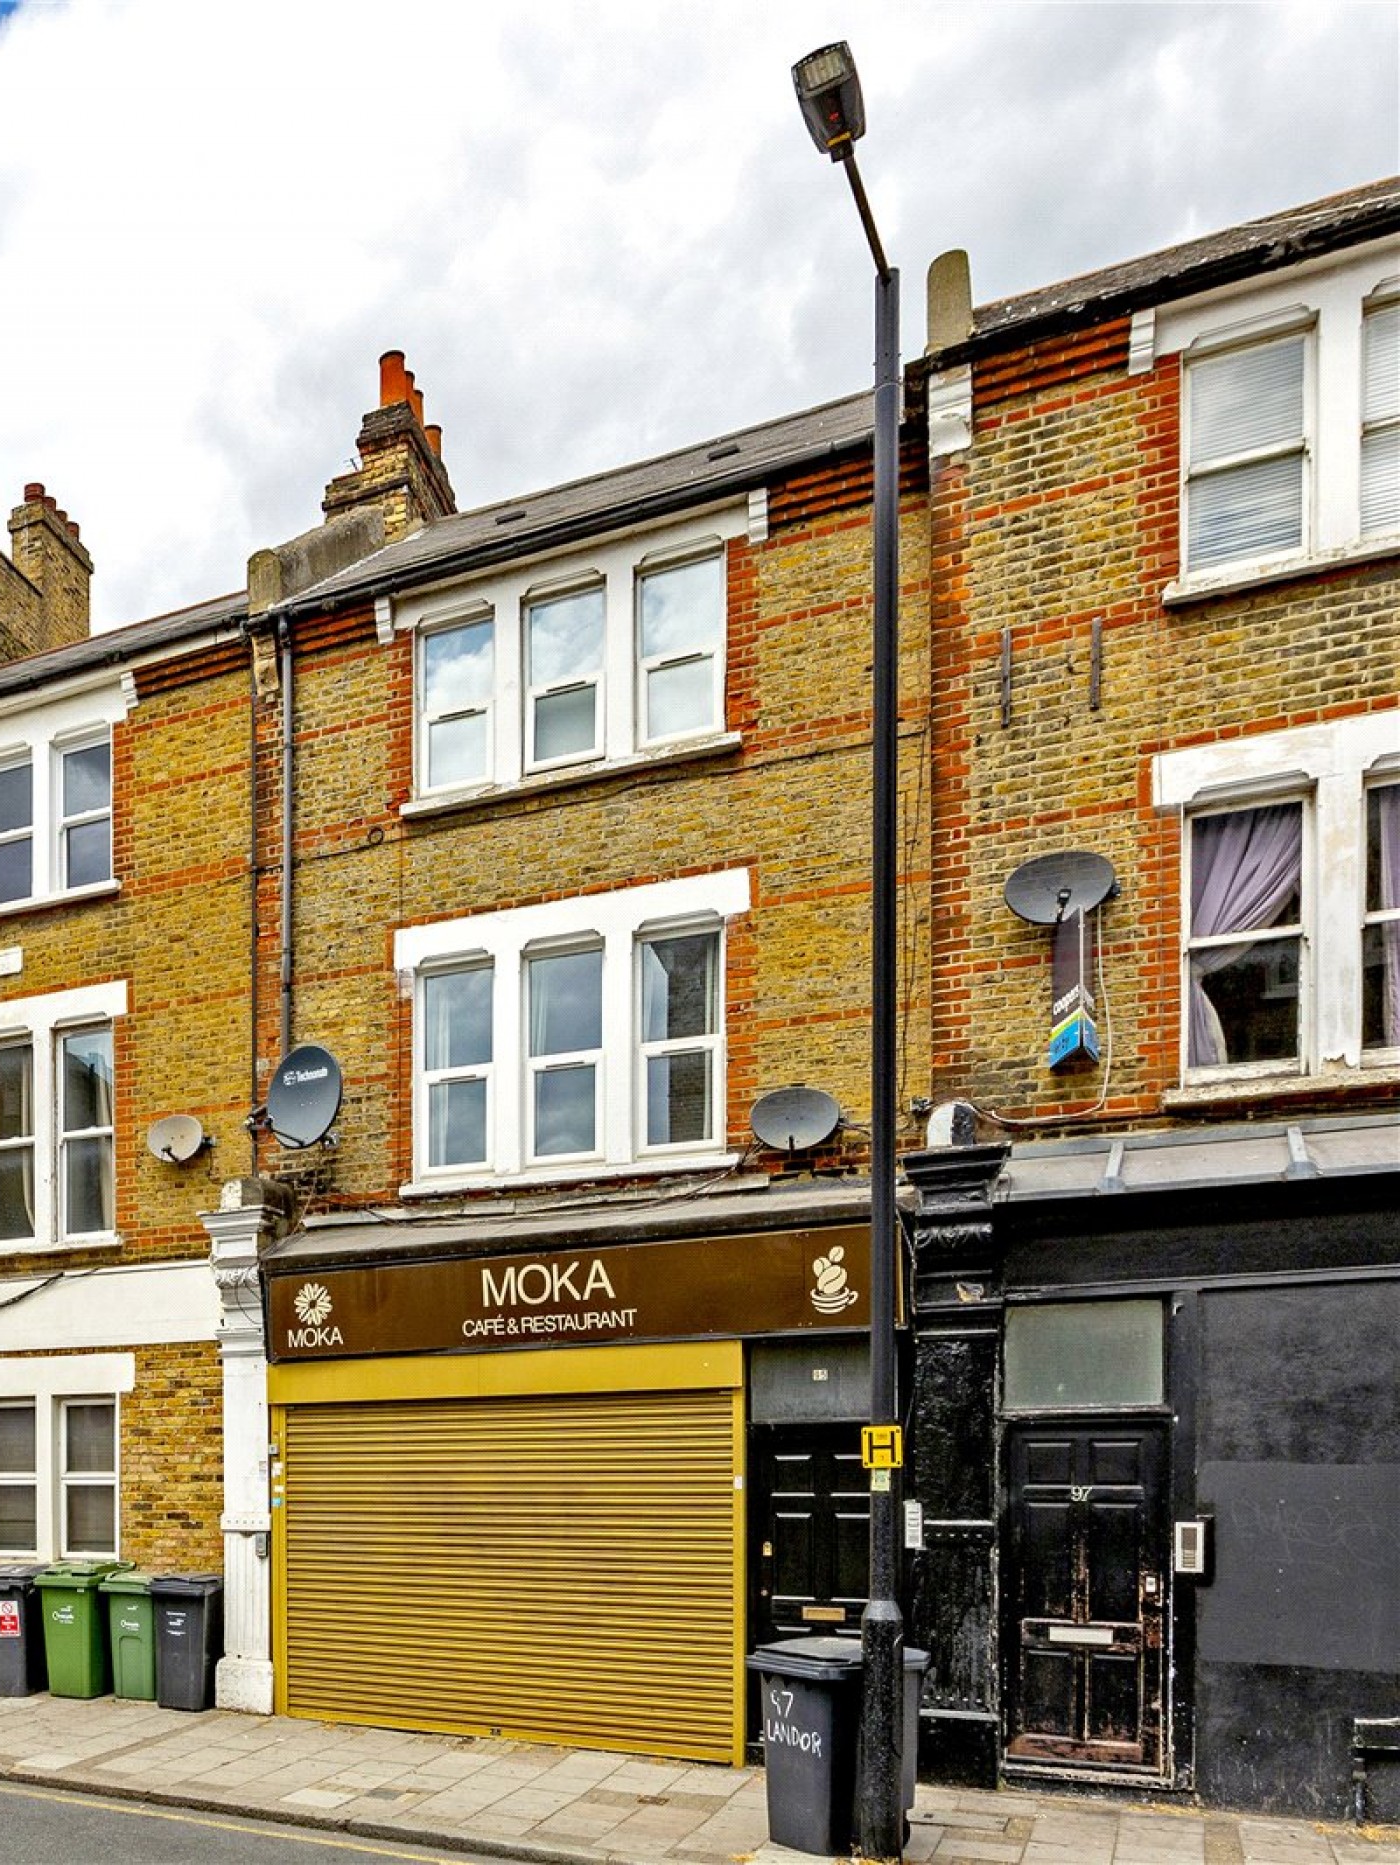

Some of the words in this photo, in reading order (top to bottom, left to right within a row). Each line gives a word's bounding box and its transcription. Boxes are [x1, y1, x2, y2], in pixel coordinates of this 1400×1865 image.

[482, 1259, 616, 1308] MOKA
[288, 1326, 344, 1348] MOKA
[462, 1313, 503, 1338] CAFÉ
[506, 1316, 520, 1334] &
[520, 1308, 637, 1334] RESTAURANT
[868, 1430, 896, 1464] H
[1071, 1485, 1093, 1502] 97
[766, 1718, 821, 1758] LANDOR
